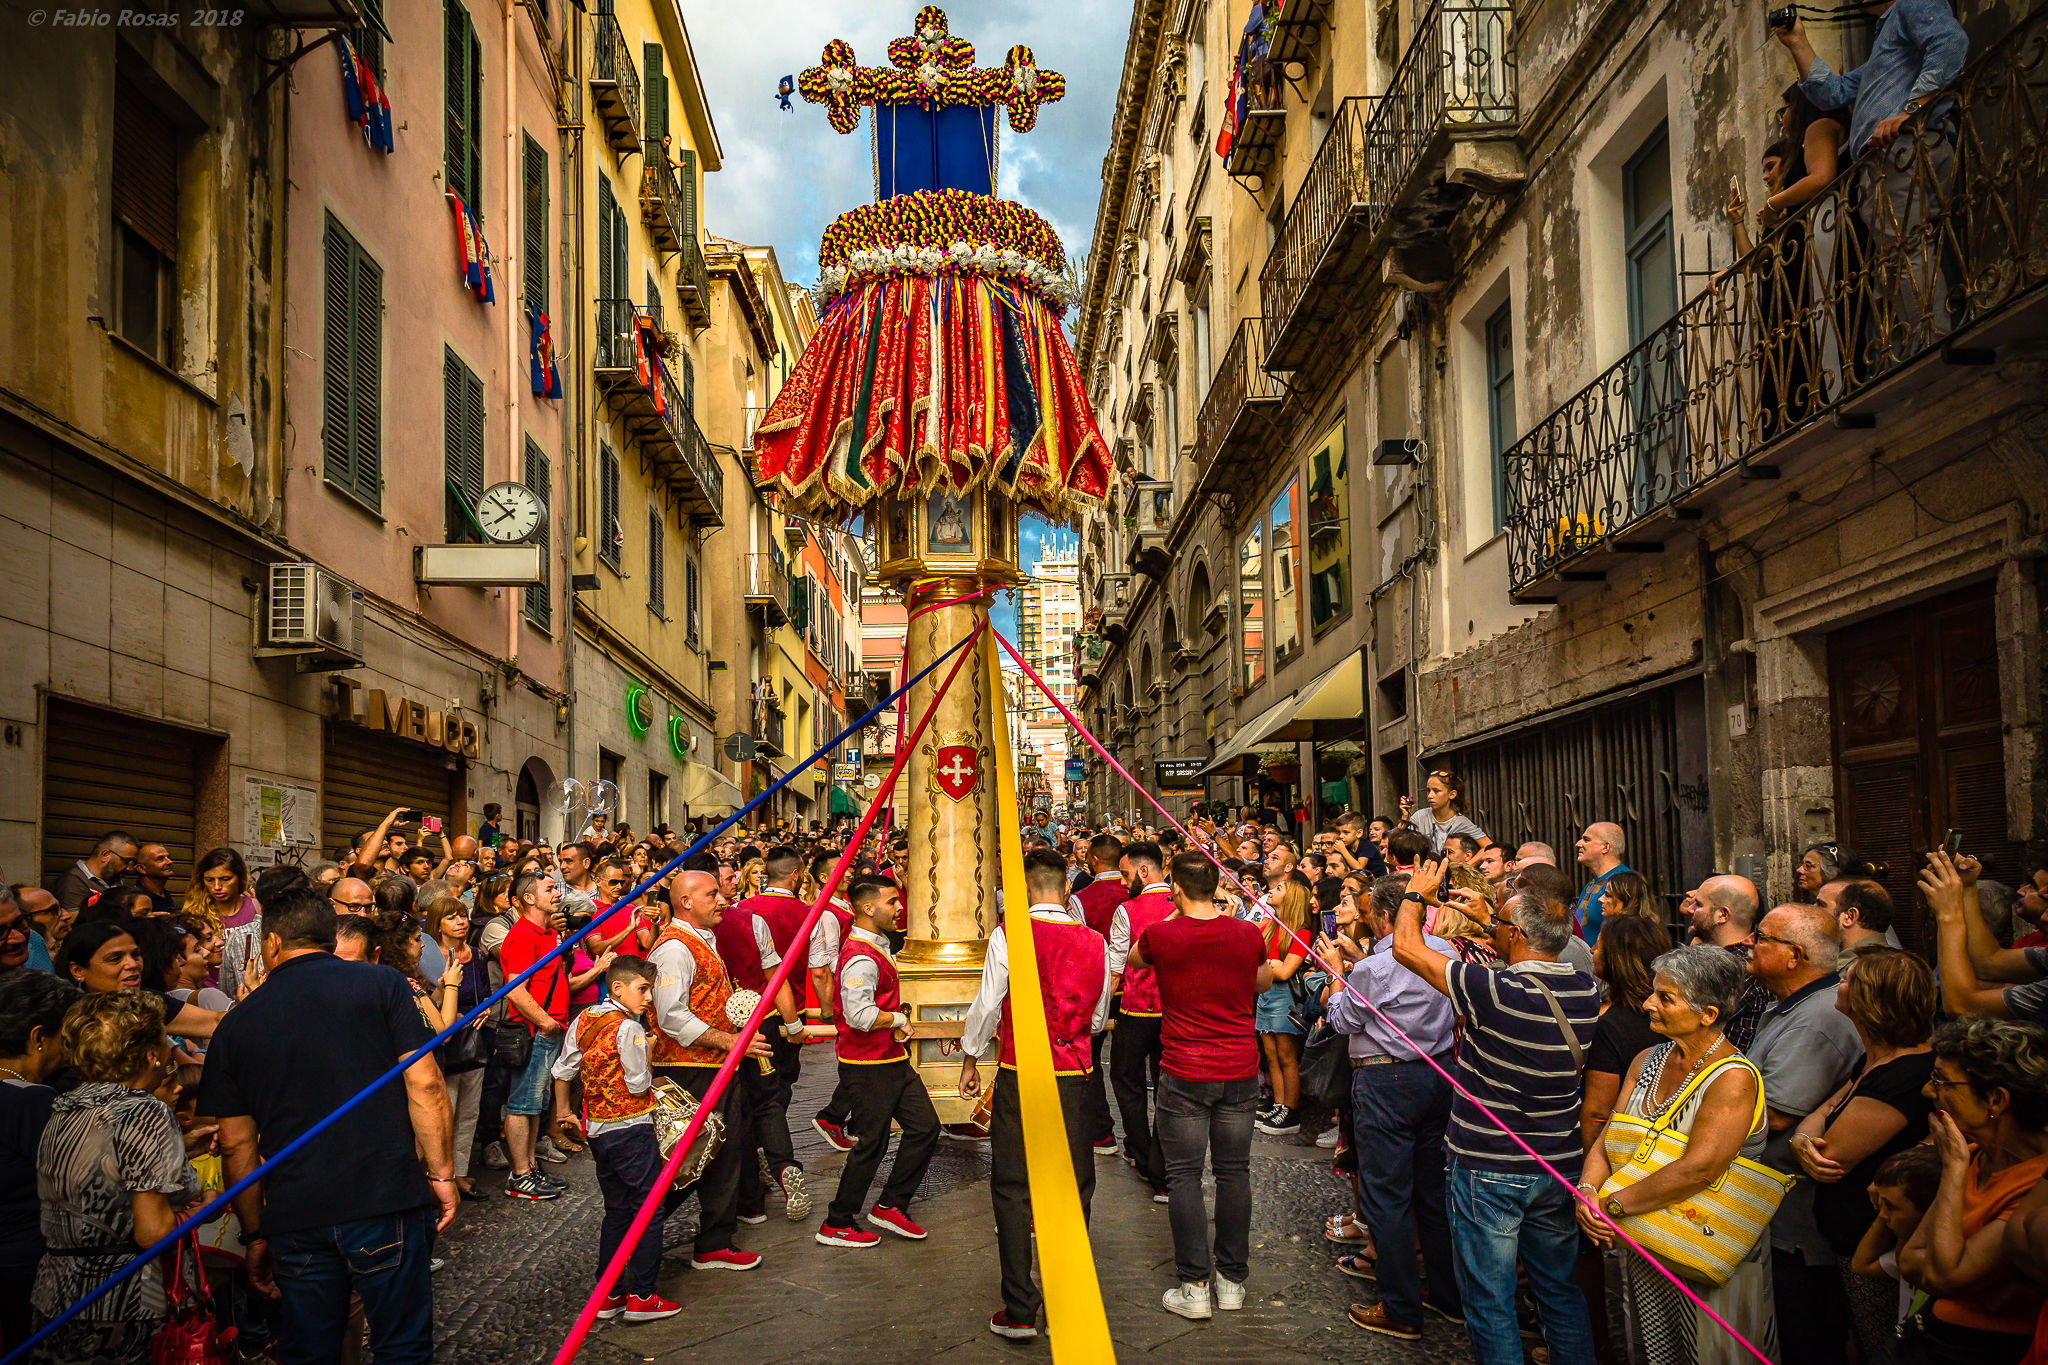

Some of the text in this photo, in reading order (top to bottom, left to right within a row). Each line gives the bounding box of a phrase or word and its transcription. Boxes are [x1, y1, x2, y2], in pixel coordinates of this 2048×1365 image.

[369, 688, 480, 760] MEUCCI
[1731, 713, 1742, 728] 70
[848, 749, 858, 761] T
